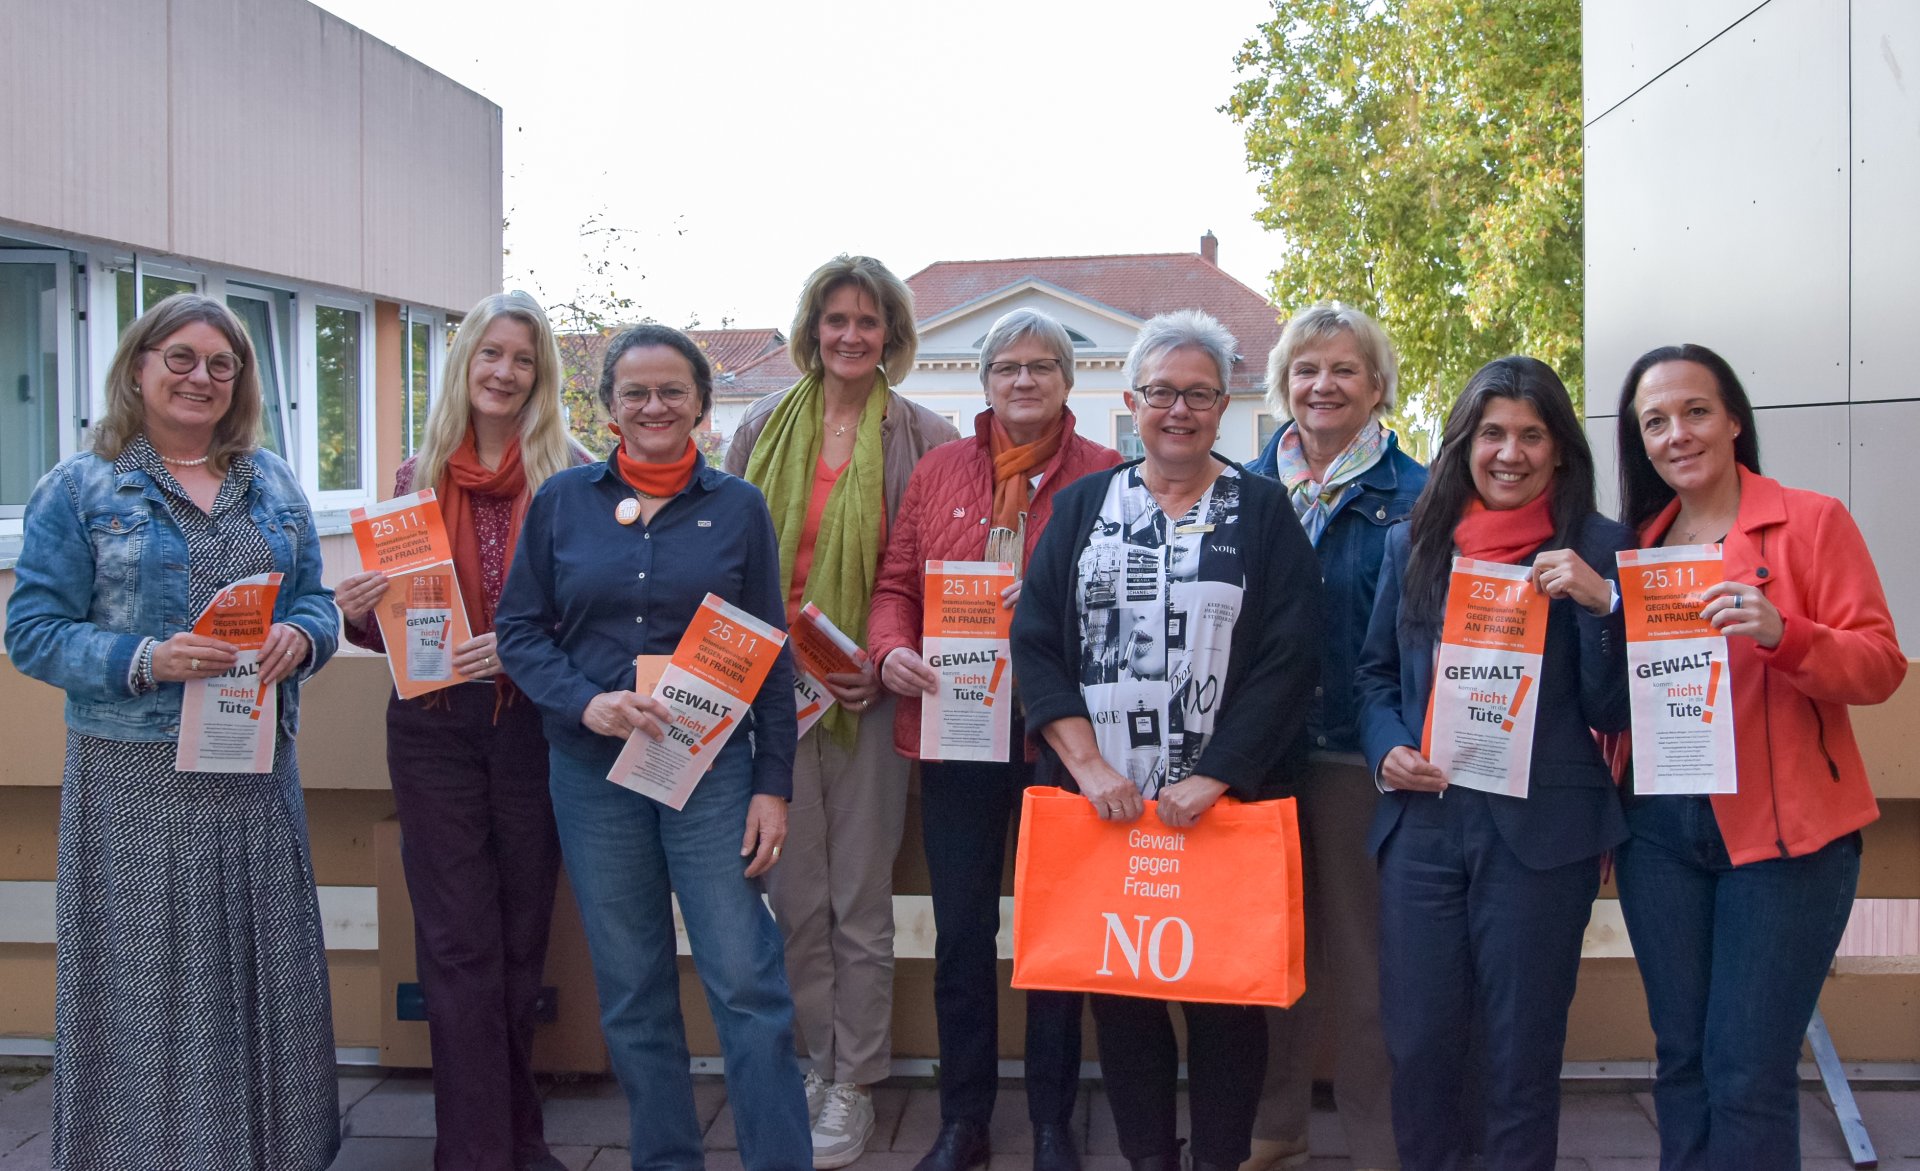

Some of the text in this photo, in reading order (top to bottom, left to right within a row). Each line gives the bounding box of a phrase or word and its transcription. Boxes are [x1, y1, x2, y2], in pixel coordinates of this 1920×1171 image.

[371, 512, 426, 538] 25.11.
[378, 537, 430, 556] GEGEN GEWALT
[380, 556, 393, 565] AN
[395, 544, 432, 561] FRAUEN
[1211, 544, 1237, 555] NOIR
[1642, 567, 1703, 589] 25.11.
[943, 579, 996, 596] 25.11.
[1470, 581, 1529, 603] 25.11.
[217, 589, 261, 608] 25.11.
[1646, 601, 1700, 611] GEGEN GEWALT
[1467, 603, 1514, 614] Internationaler
[406, 615, 446, 627] GEWALT
[942, 616, 996, 624] AN FRAUEN
[1466, 613, 1526, 625] GEGEN GEWALT
[1647, 613, 1662, 624] AN
[211, 626, 264, 637] AN FRAUEN
[421, 628, 440, 637] nicht
[708, 619, 758, 657] 25.11.
[1465, 622, 1525, 636] AN FRAUEN
[694, 652, 708, 664] AN
[709, 661, 745, 683] FRAUEN
[699, 644, 749, 674] GEGEN GEWALT
[929, 650, 998, 668] GEWALT
[1636, 651, 1713, 679] GEWALT
[954, 674, 987, 685] nicht
[1171, 662, 1192, 694] Dior
[1445, 666, 1524, 680] GEWALT
[220, 687, 254, 698] nicht
[1470, 690, 1508, 705] nicht
[1667, 683, 1703, 697] nicht
[662, 685, 732, 718] GEWALT
[676, 714, 708, 734] nicht
[1092, 711, 1120, 724] GUE
[1128, 829, 1185, 851] Gewalt
[1129, 855, 1180, 876] gegen
[1123, 876, 1180, 899] Frauen
[1095, 911, 1194, 983] NO
